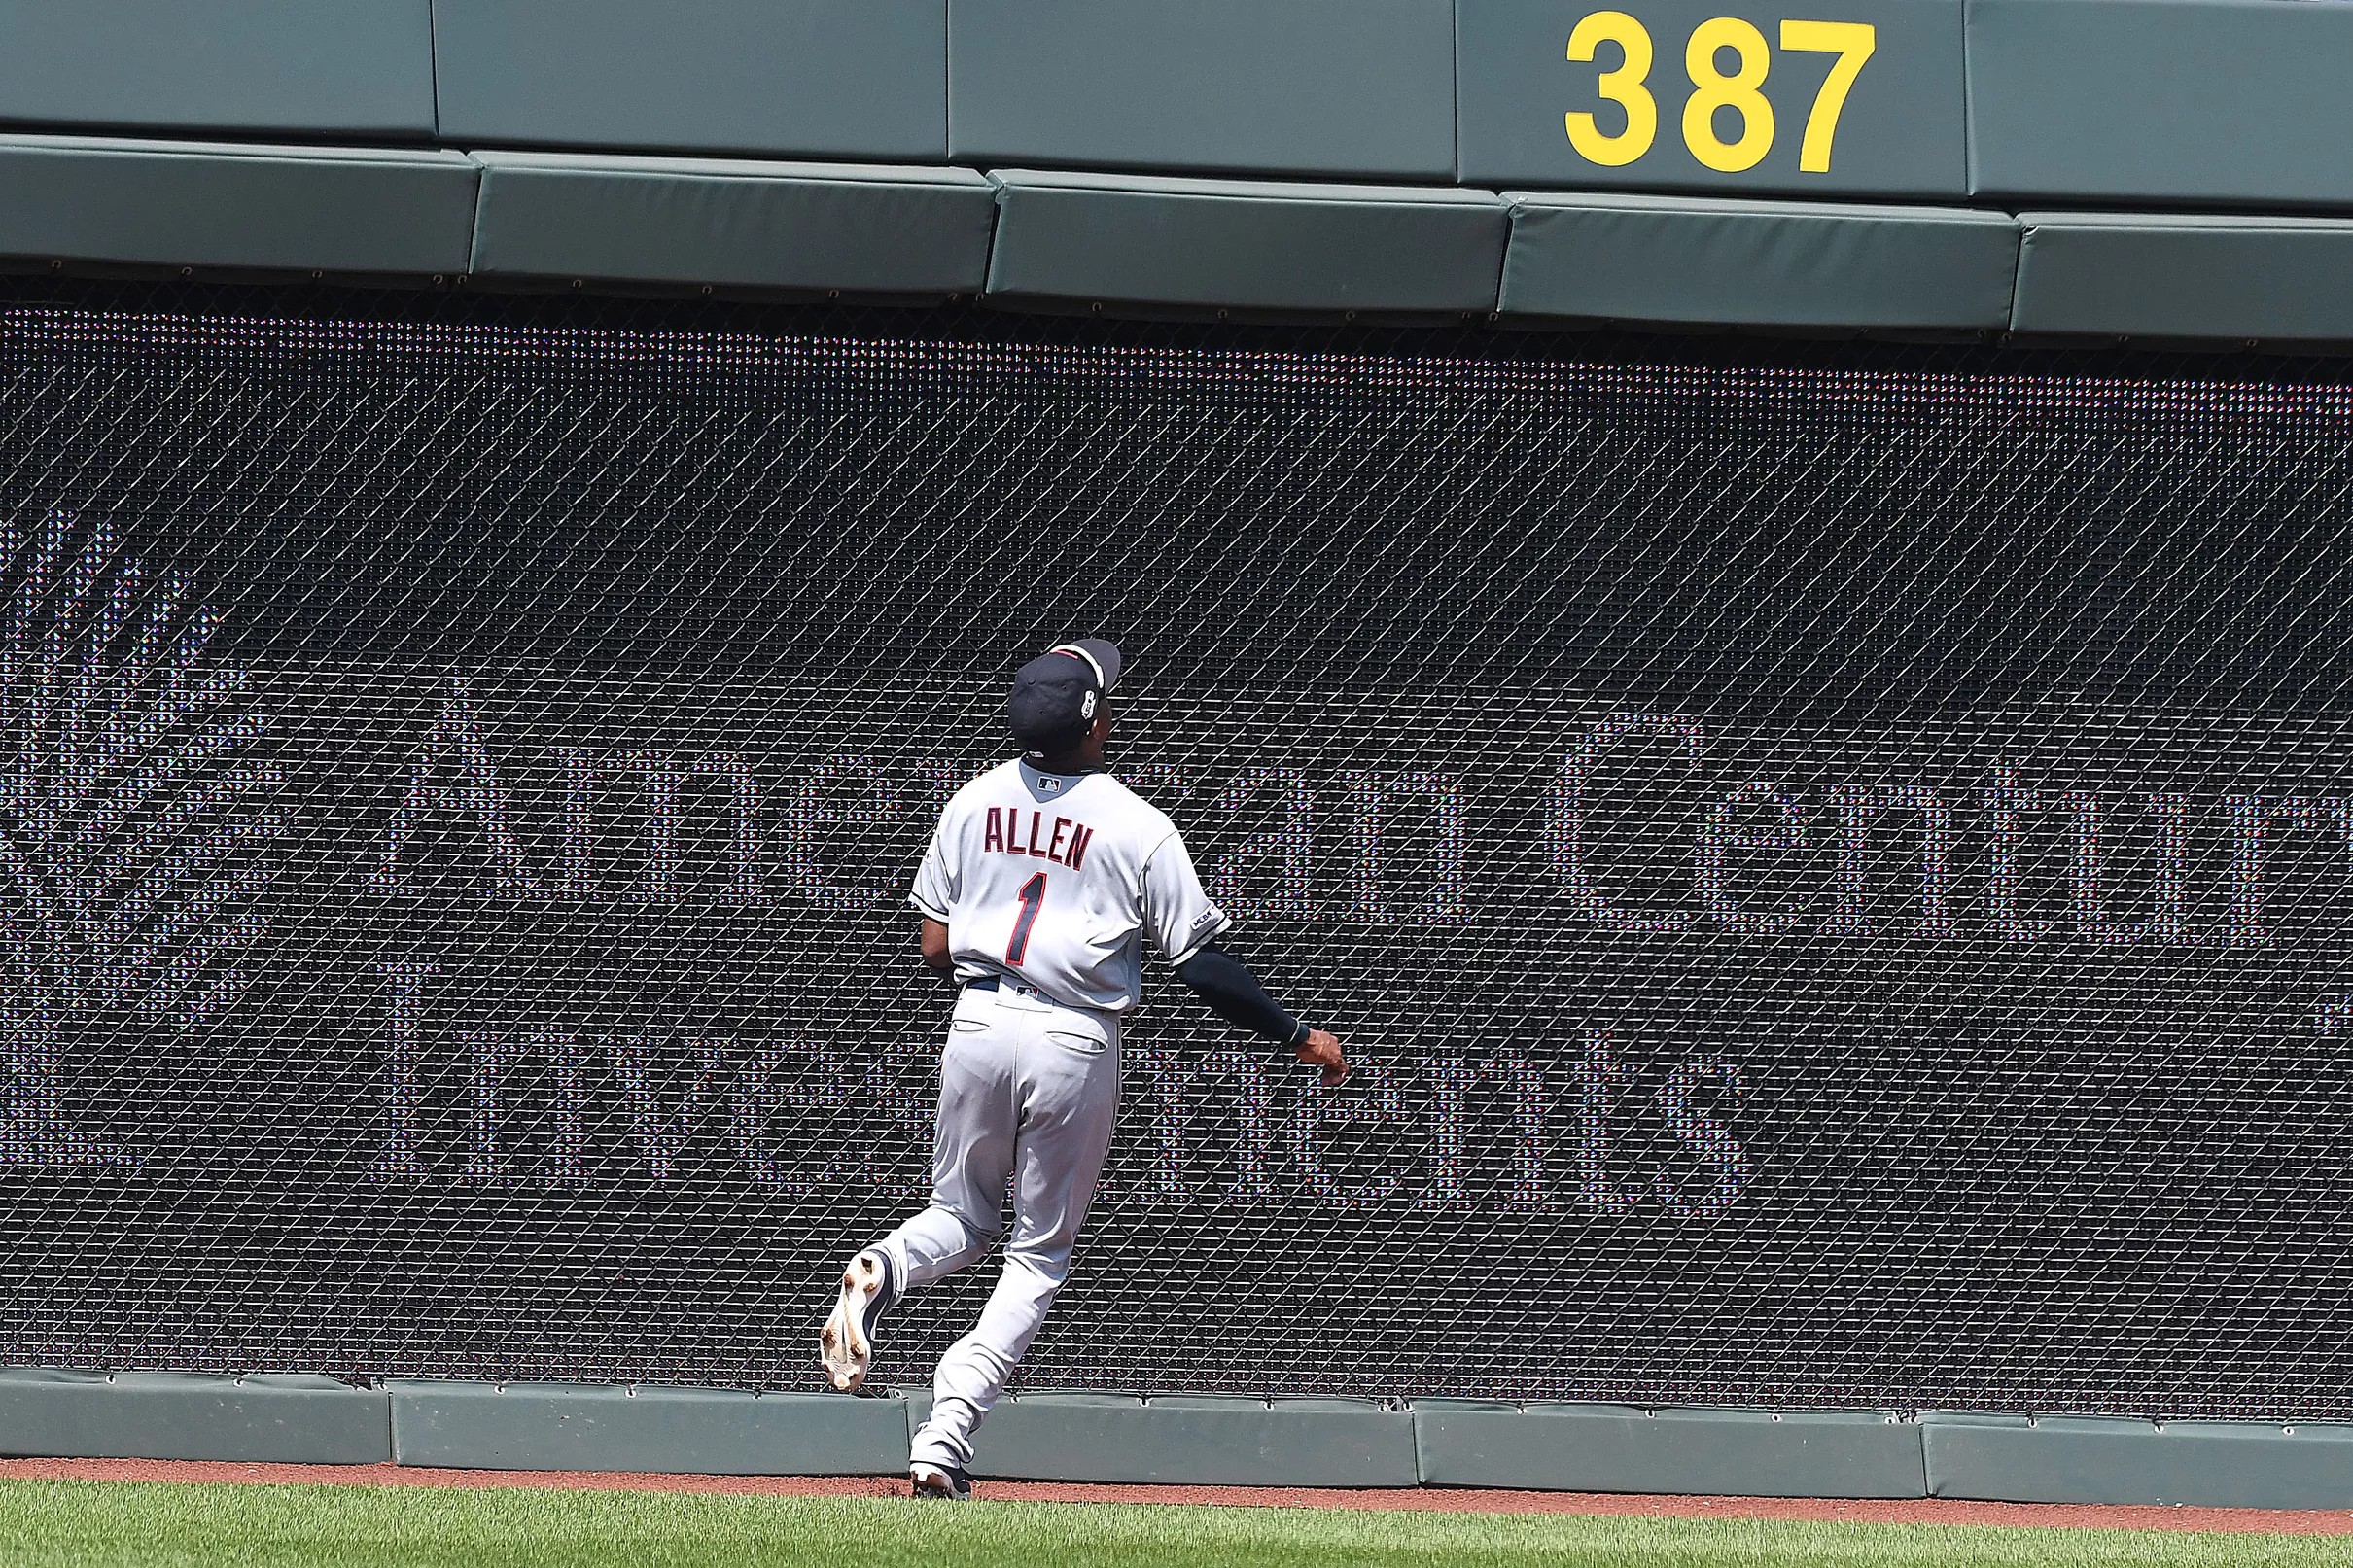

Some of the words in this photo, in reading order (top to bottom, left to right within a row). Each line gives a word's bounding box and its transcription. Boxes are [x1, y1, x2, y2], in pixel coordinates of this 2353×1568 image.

[1564, 10, 1876, 173] 387
[364, 668, 1476, 925] Amean
[984, 806, 1094, 872] ALLEN
[1005, 871, 1048, 966] 1
[366, 958, 1749, 1218] Invesments
